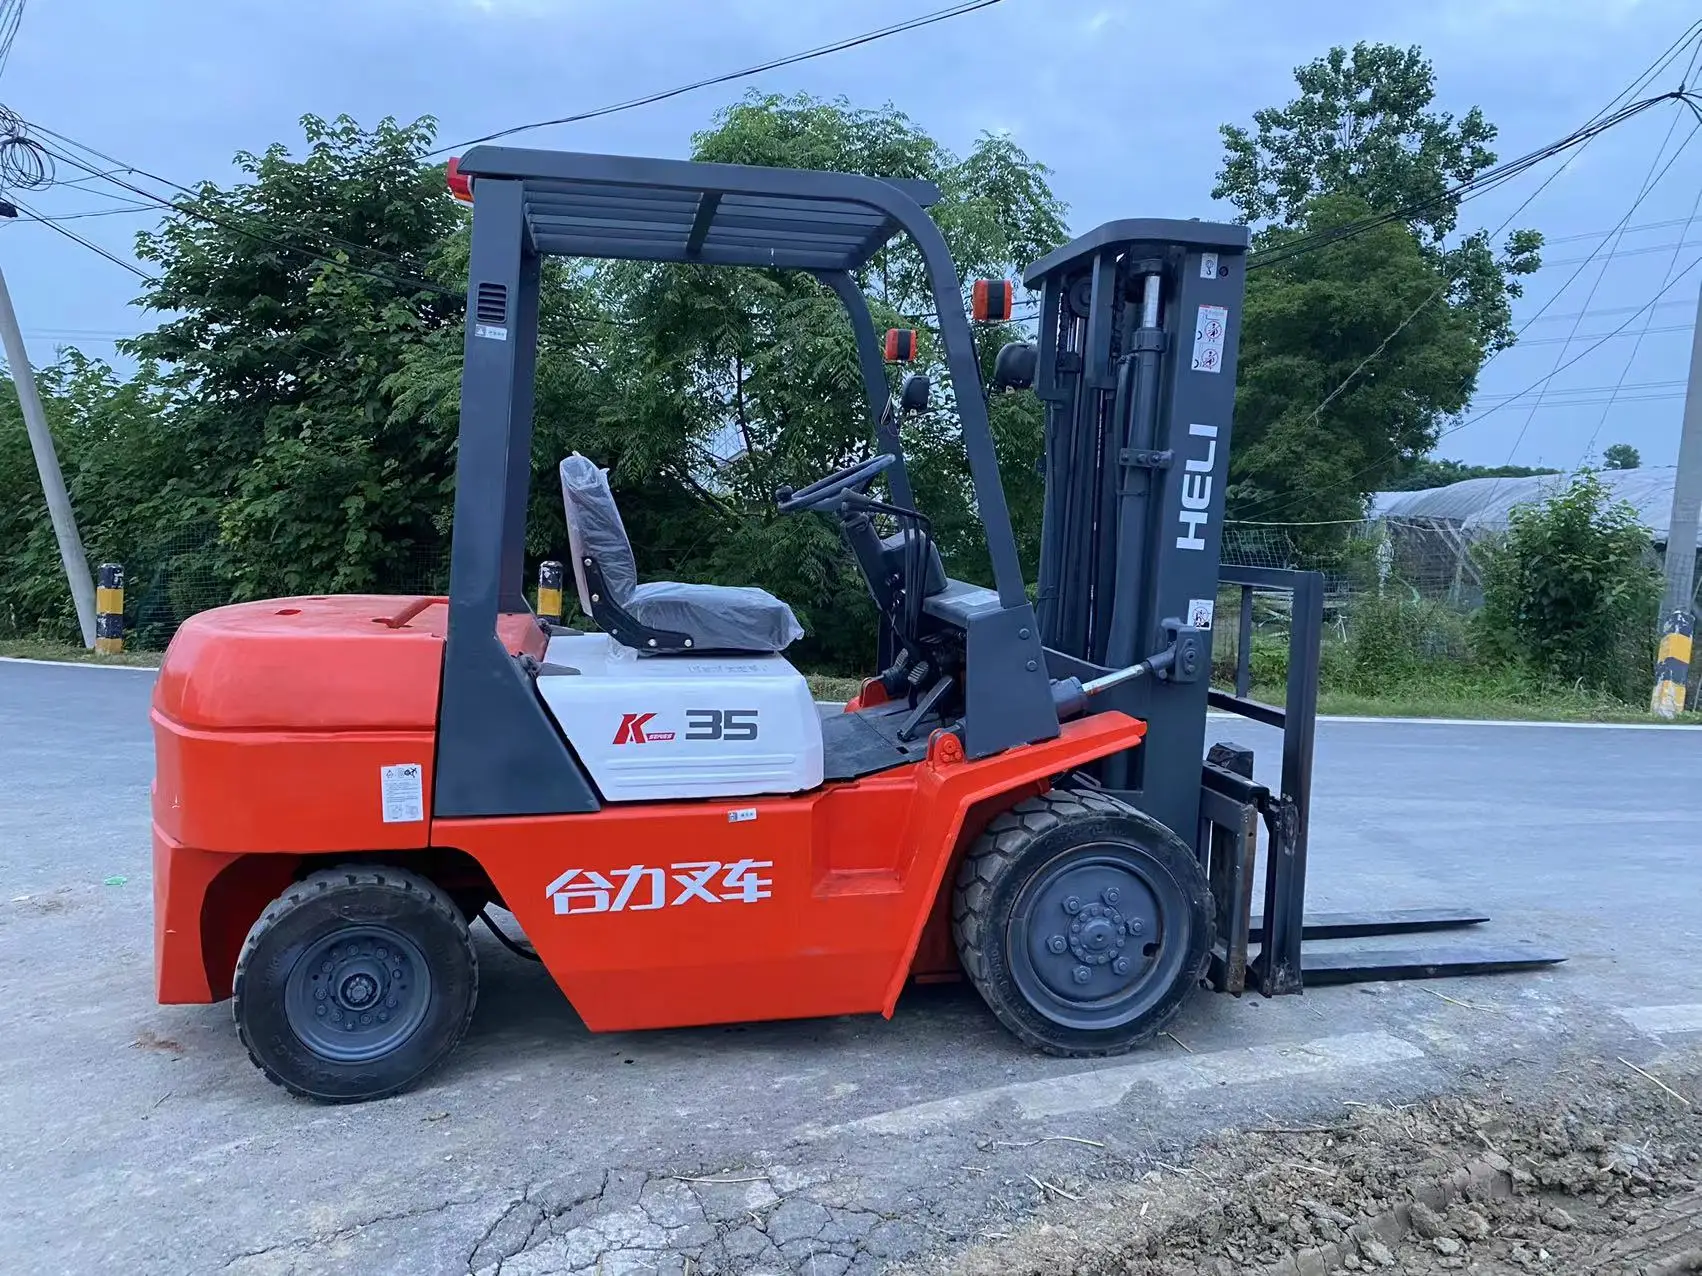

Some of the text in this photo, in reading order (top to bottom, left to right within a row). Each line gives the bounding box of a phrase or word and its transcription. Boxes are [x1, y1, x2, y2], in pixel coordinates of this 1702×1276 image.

[1176, 423, 1218, 550] HELI
[612, 712, 658, 744] K
[685, 709, 758, 741] 35
[545, 858, 773, 915] 合力叉车
